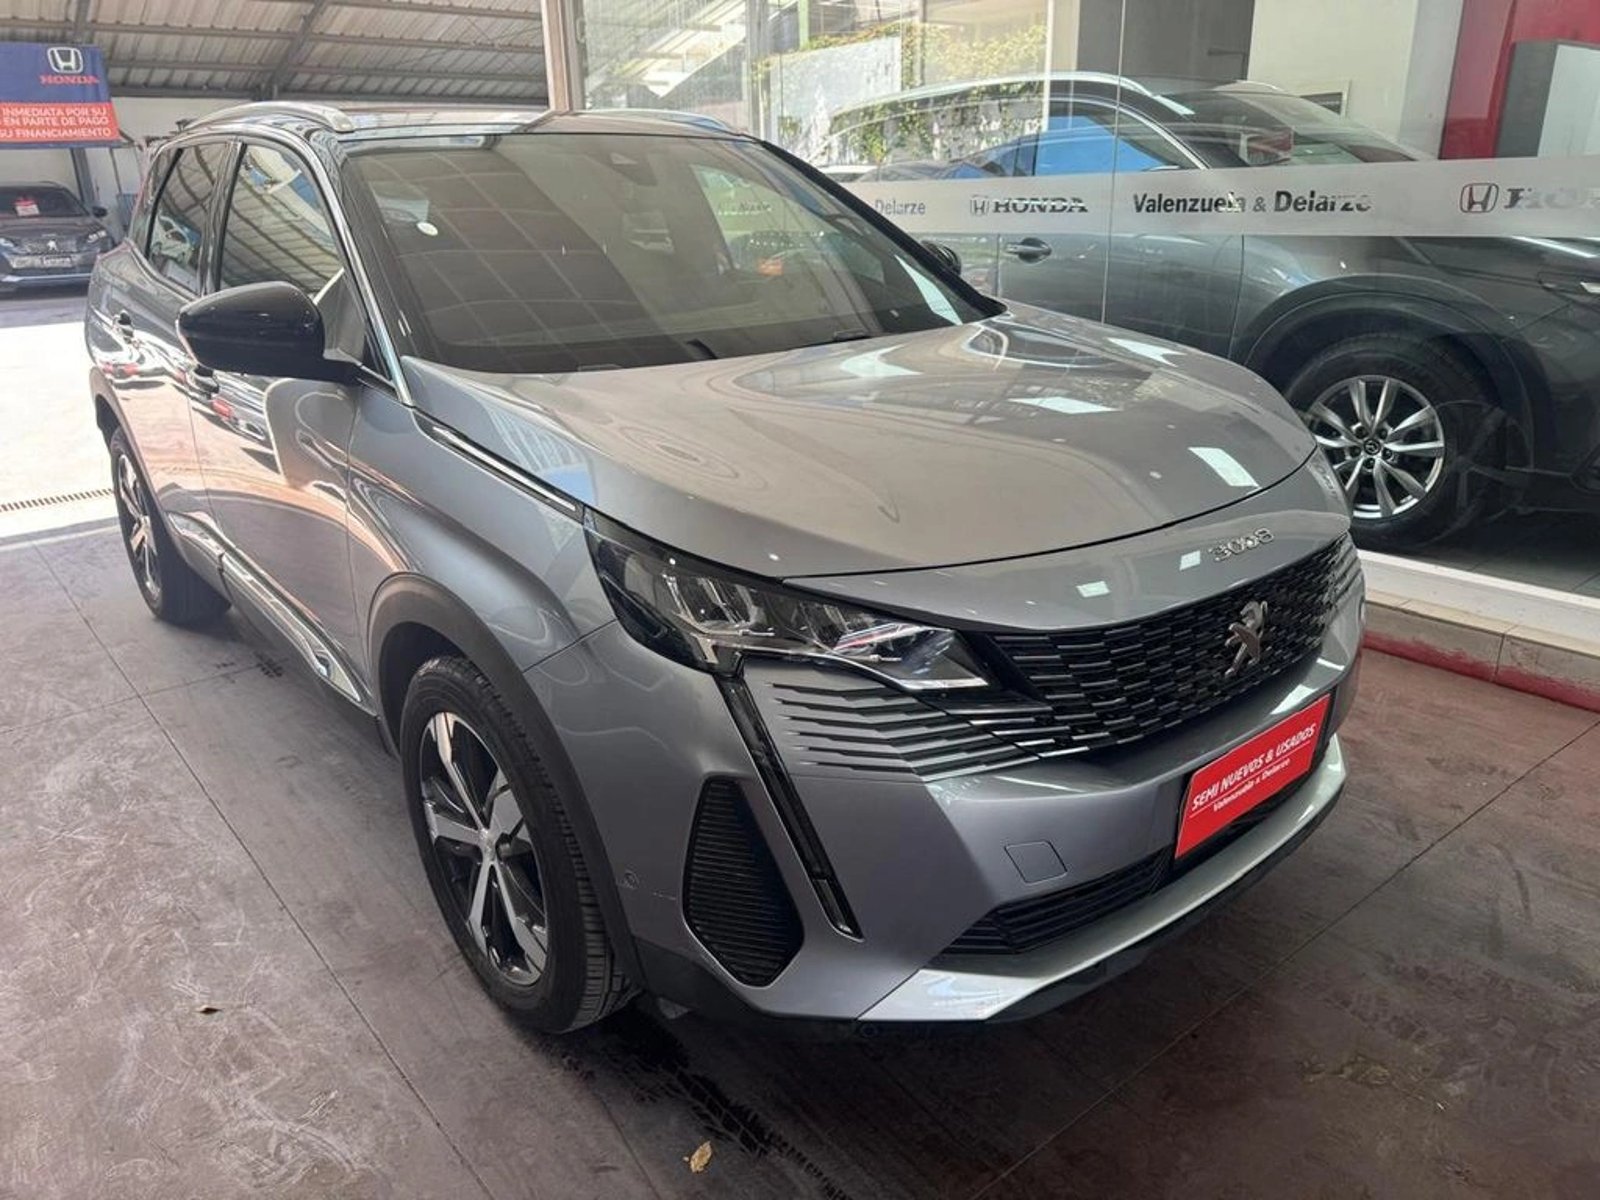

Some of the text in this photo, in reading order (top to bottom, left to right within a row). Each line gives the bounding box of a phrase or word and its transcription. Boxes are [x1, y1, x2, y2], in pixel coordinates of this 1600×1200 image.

[40, 75, 99, 85] HONDA
[91, 107, 106, 116] SU
[23, 117, 57, 126] PARTE
[61, 116, 77, 126] DE
[79, 116, 109, 125] PAGO
[993, 197, 1088, 213] HONDA
[1133, 191, 1247, 214] Valenzuela
[1252, 196, 1267, 213] &
[1207, 527, 1274, 562] 3008
[1192, 782, 1220, 811] SEMI
[1220, 753, 1265, 792] NUEVOS
[1276, 723, 1317, 758] USADOS
